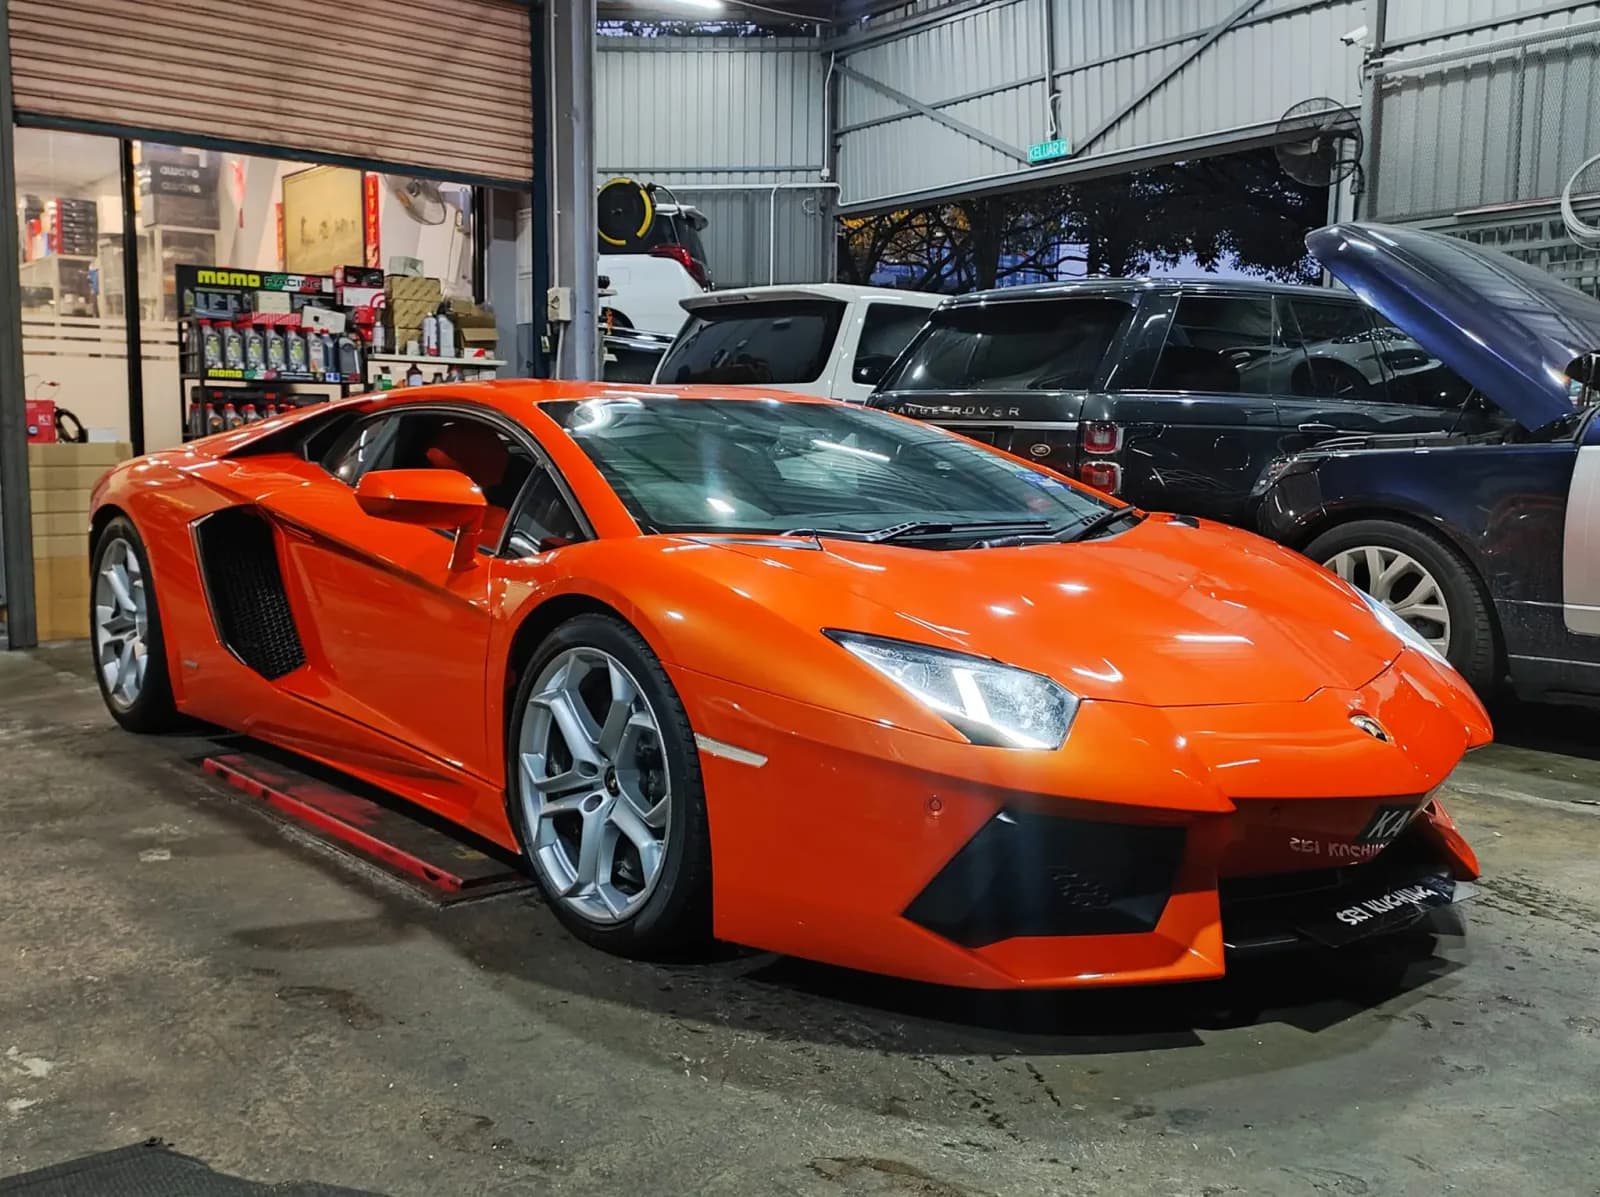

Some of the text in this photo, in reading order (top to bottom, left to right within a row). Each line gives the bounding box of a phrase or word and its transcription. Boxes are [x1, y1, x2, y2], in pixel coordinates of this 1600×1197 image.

[197, 270, 322, 290] momo RACING
[888, 405, 1021, 417] RANGE ROVER
[1335, 906, 1374, 926] SRI
